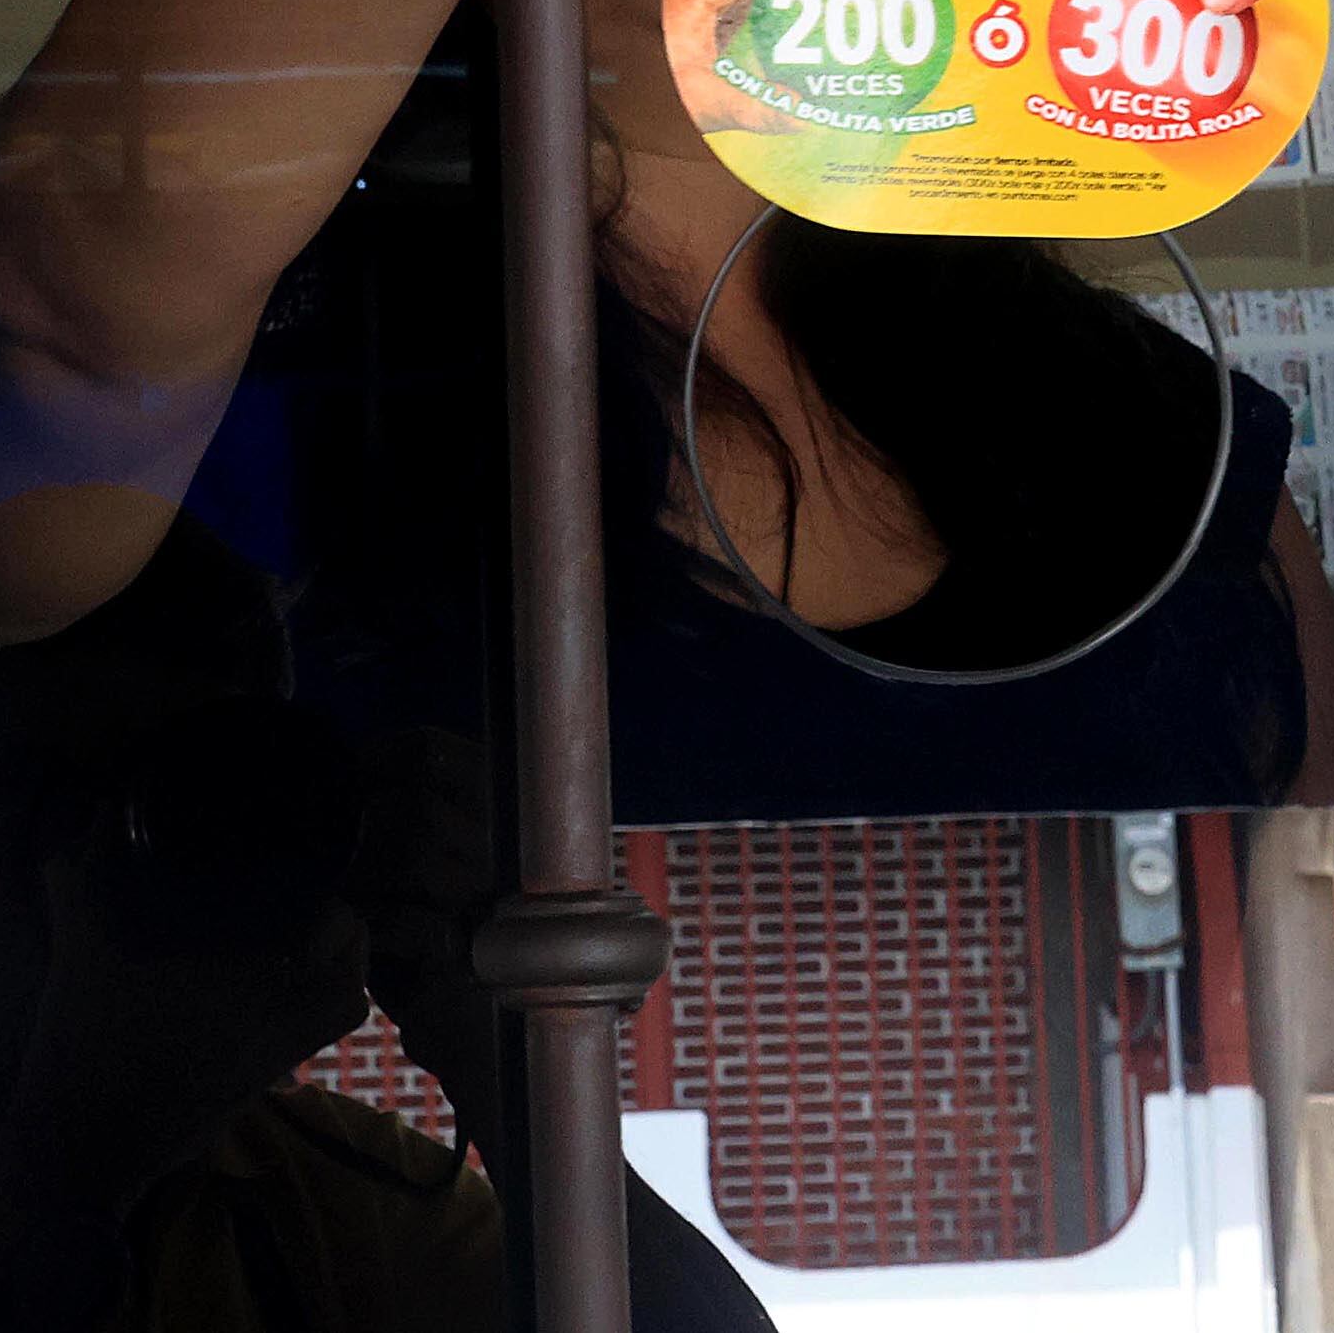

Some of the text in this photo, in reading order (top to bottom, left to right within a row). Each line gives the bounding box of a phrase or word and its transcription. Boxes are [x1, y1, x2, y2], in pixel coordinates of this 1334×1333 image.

[715, 58, 977, 134] CON LA BOLITA VERDE
[805, 73, 905, 98] VECES
[1088, 85, 1192, 122] VECES
[1025, 94, 1264, 142] CON LA BOLITA ROJA
